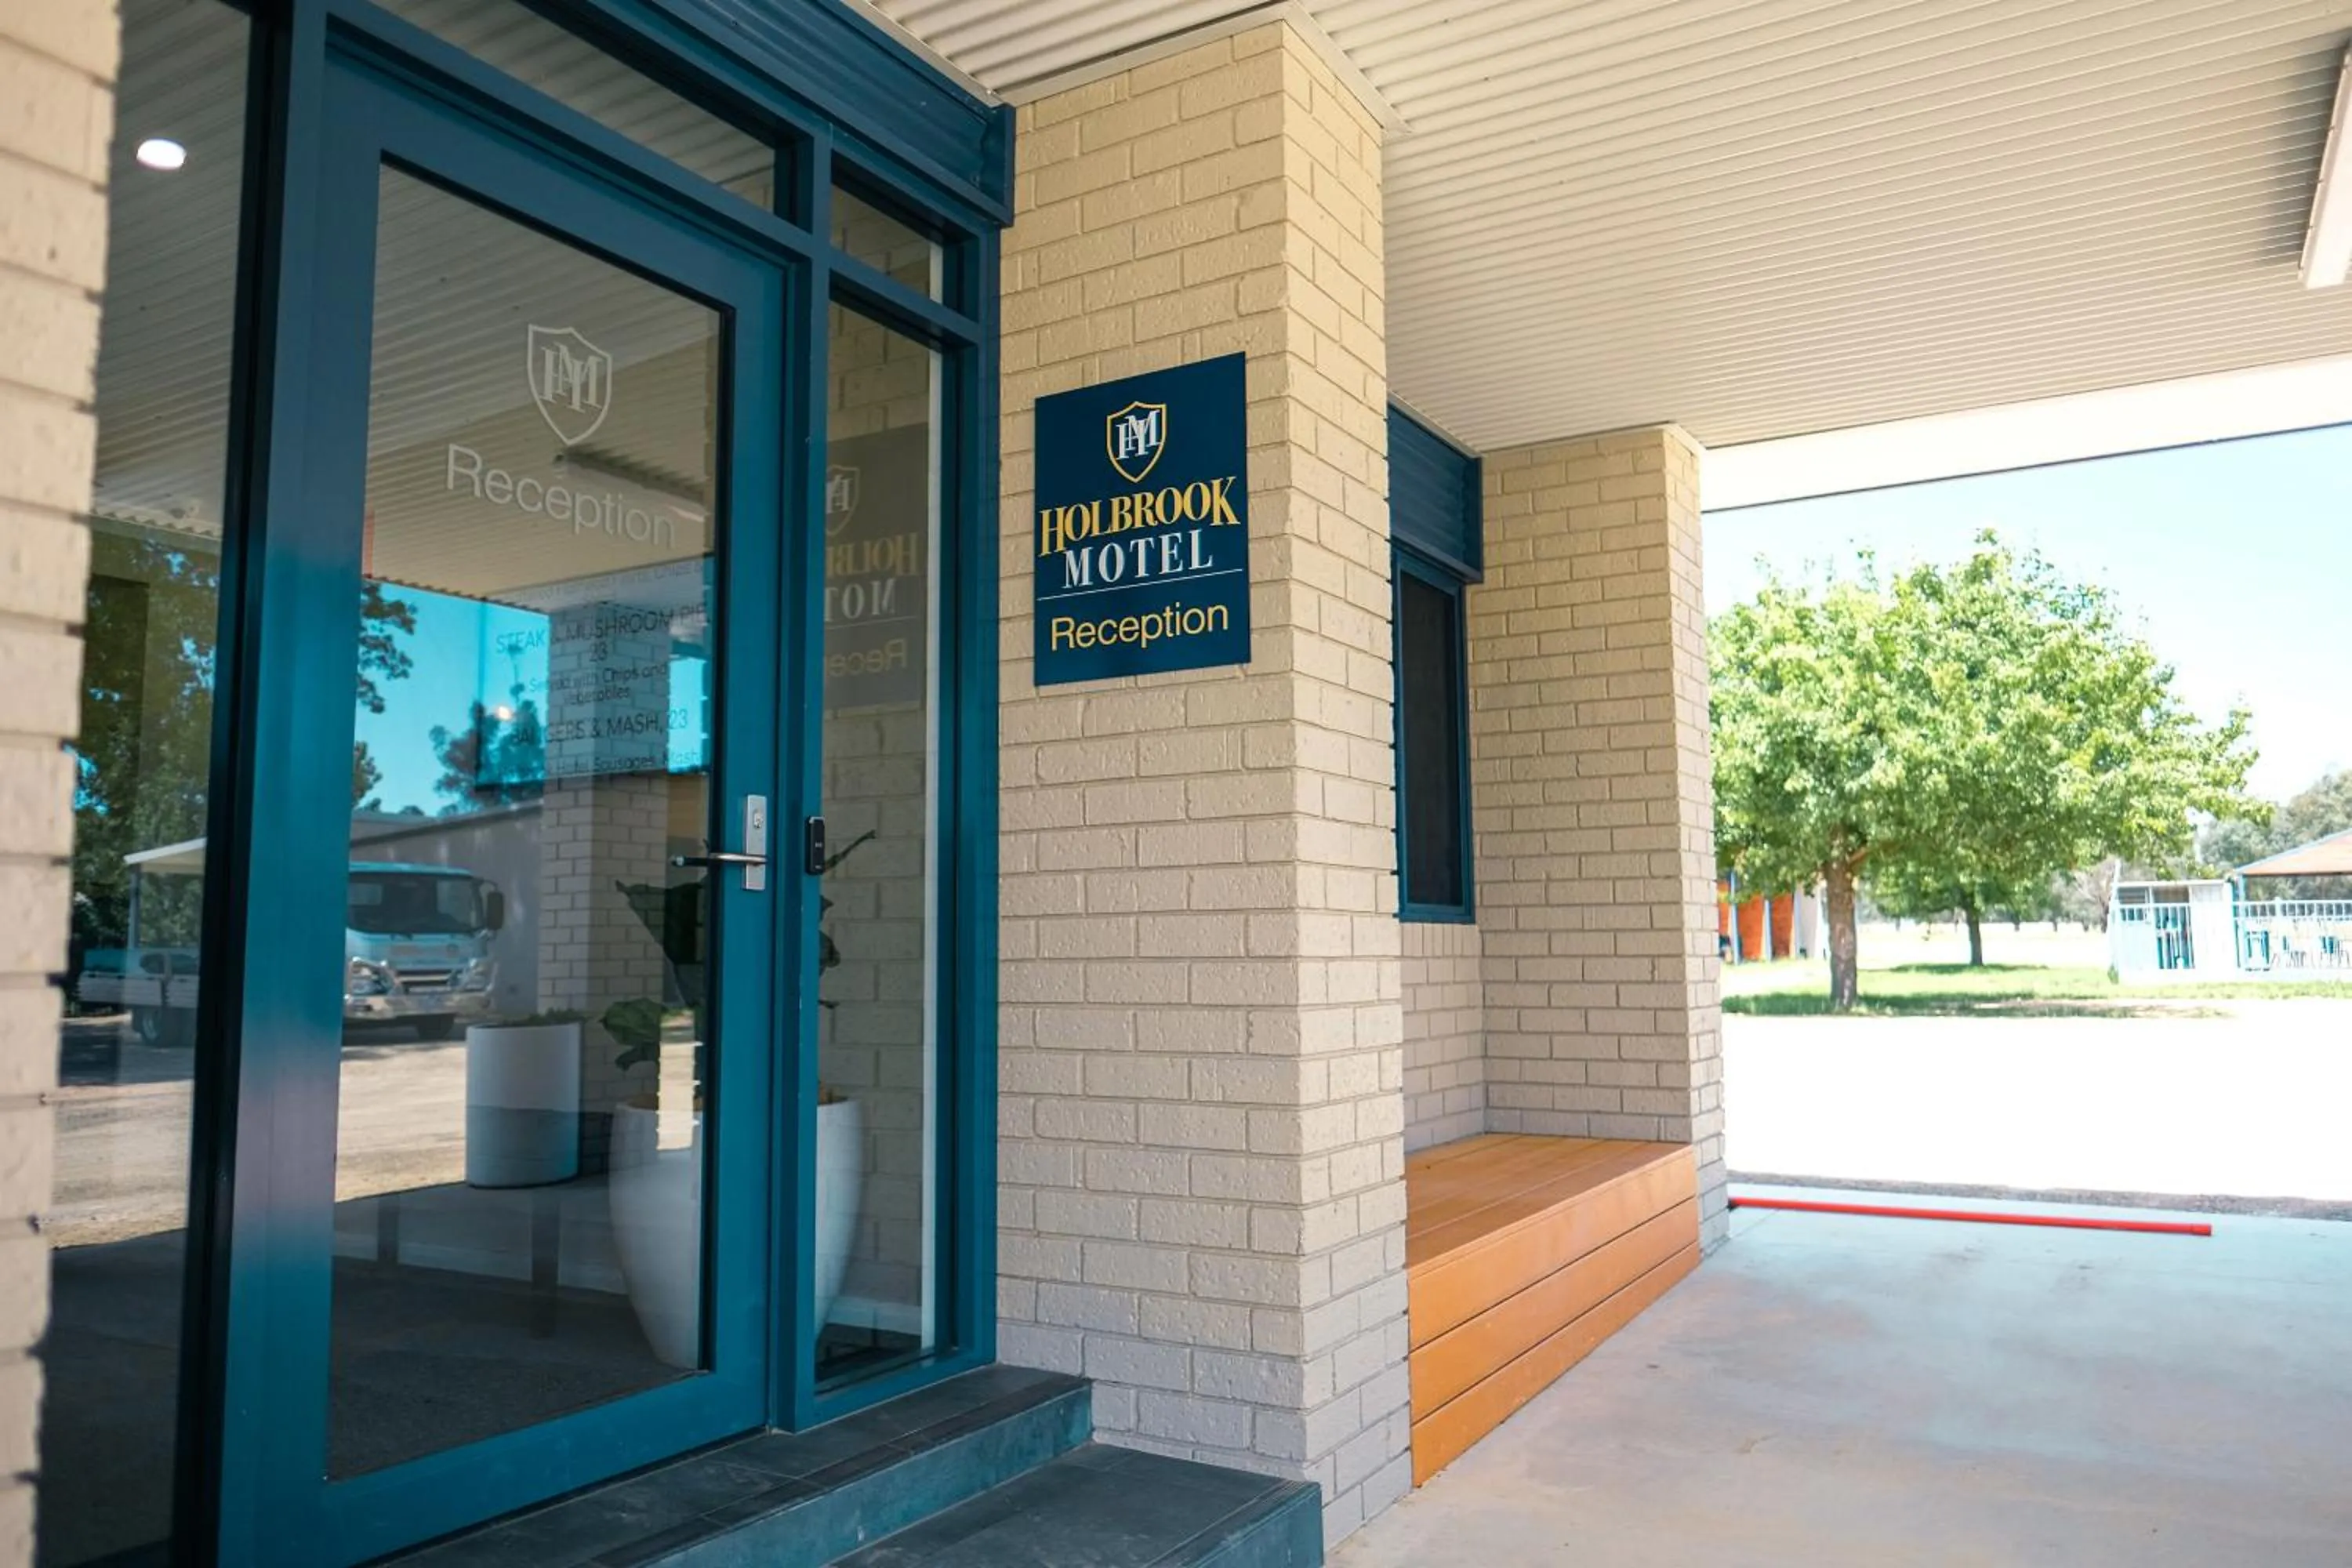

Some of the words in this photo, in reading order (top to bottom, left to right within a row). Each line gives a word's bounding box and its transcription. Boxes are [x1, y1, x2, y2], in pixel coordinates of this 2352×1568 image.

[446, 443, 676, 549] Reception
[1038, 476, 1241, 557] HOLBROOK
[1062, 528, 1214, 590] MOTEL
[495, 630, 546, 654] STEAK
[1051, 601, 1229, 651] Reception
[607, 712, 663, 737] MASH,
[668, 708, 688, 730] 23
